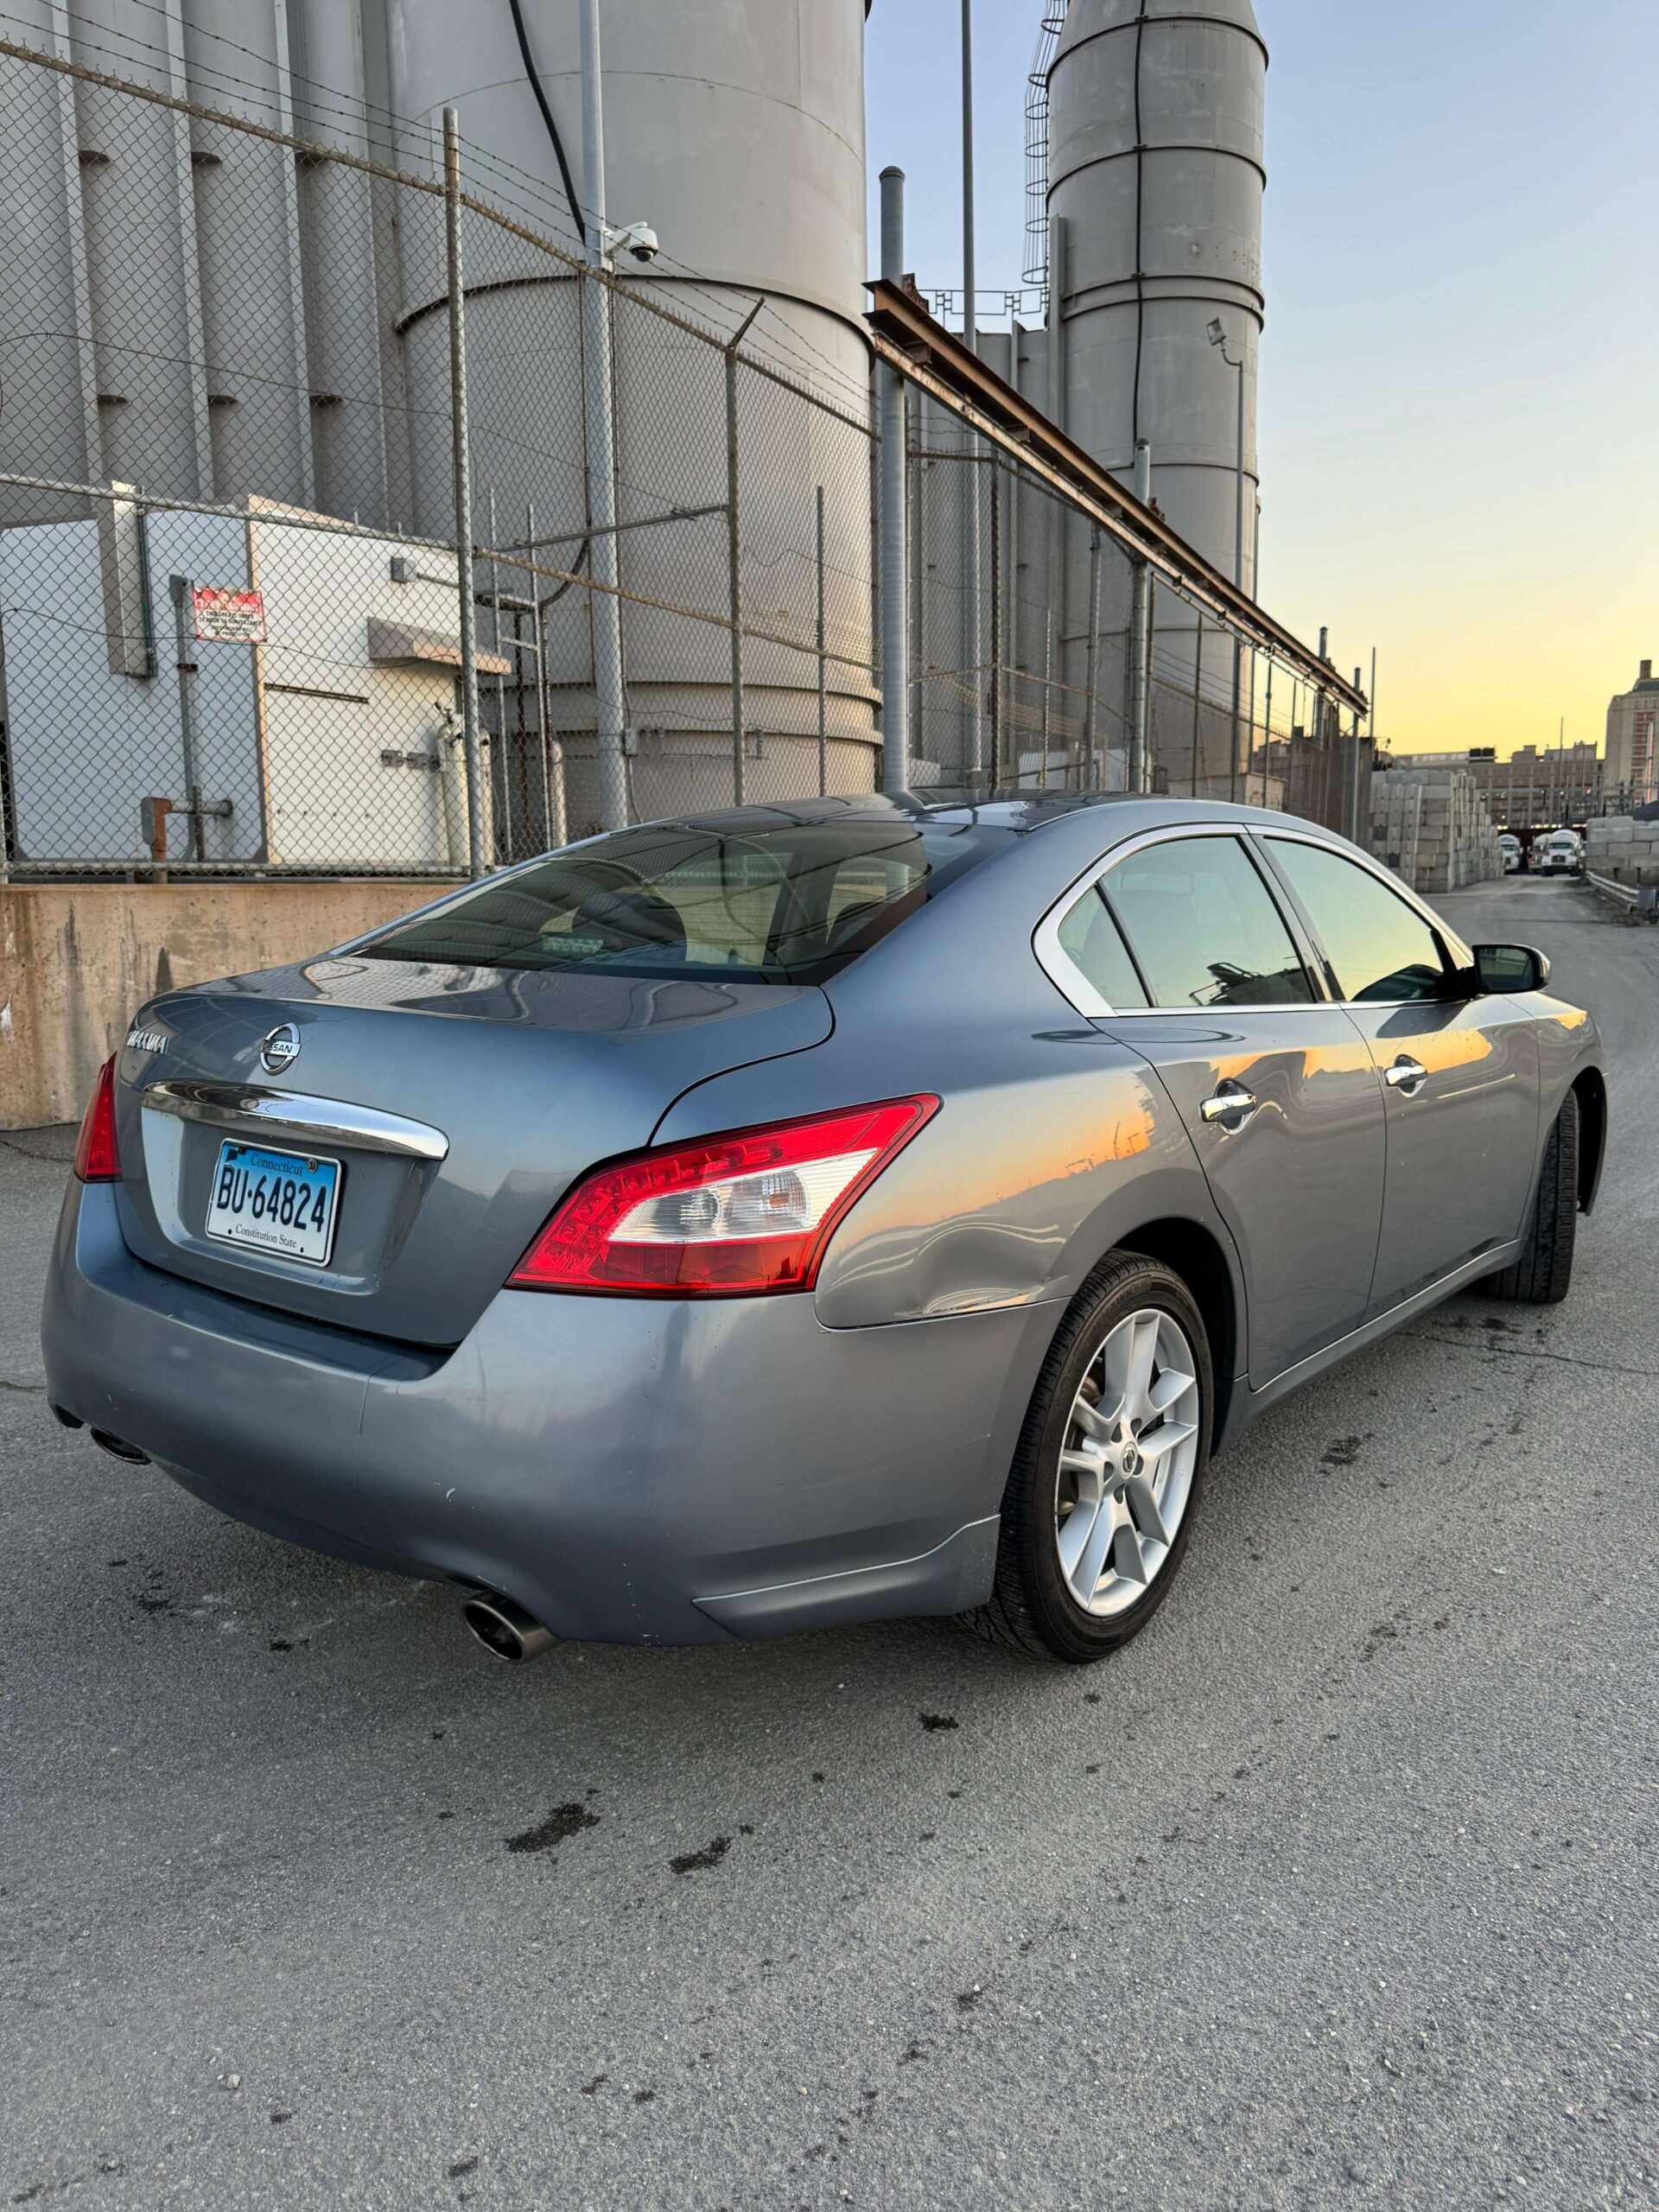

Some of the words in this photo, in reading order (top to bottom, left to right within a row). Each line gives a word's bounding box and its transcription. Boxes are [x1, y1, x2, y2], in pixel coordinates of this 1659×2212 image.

[127, 1030, 168, 1054] MAXIMA
[251, 1153, 303, 1176] Connecticut
[235, 1223, 277, 1243] Constitution
[278, 1234, 297, 1249] State
